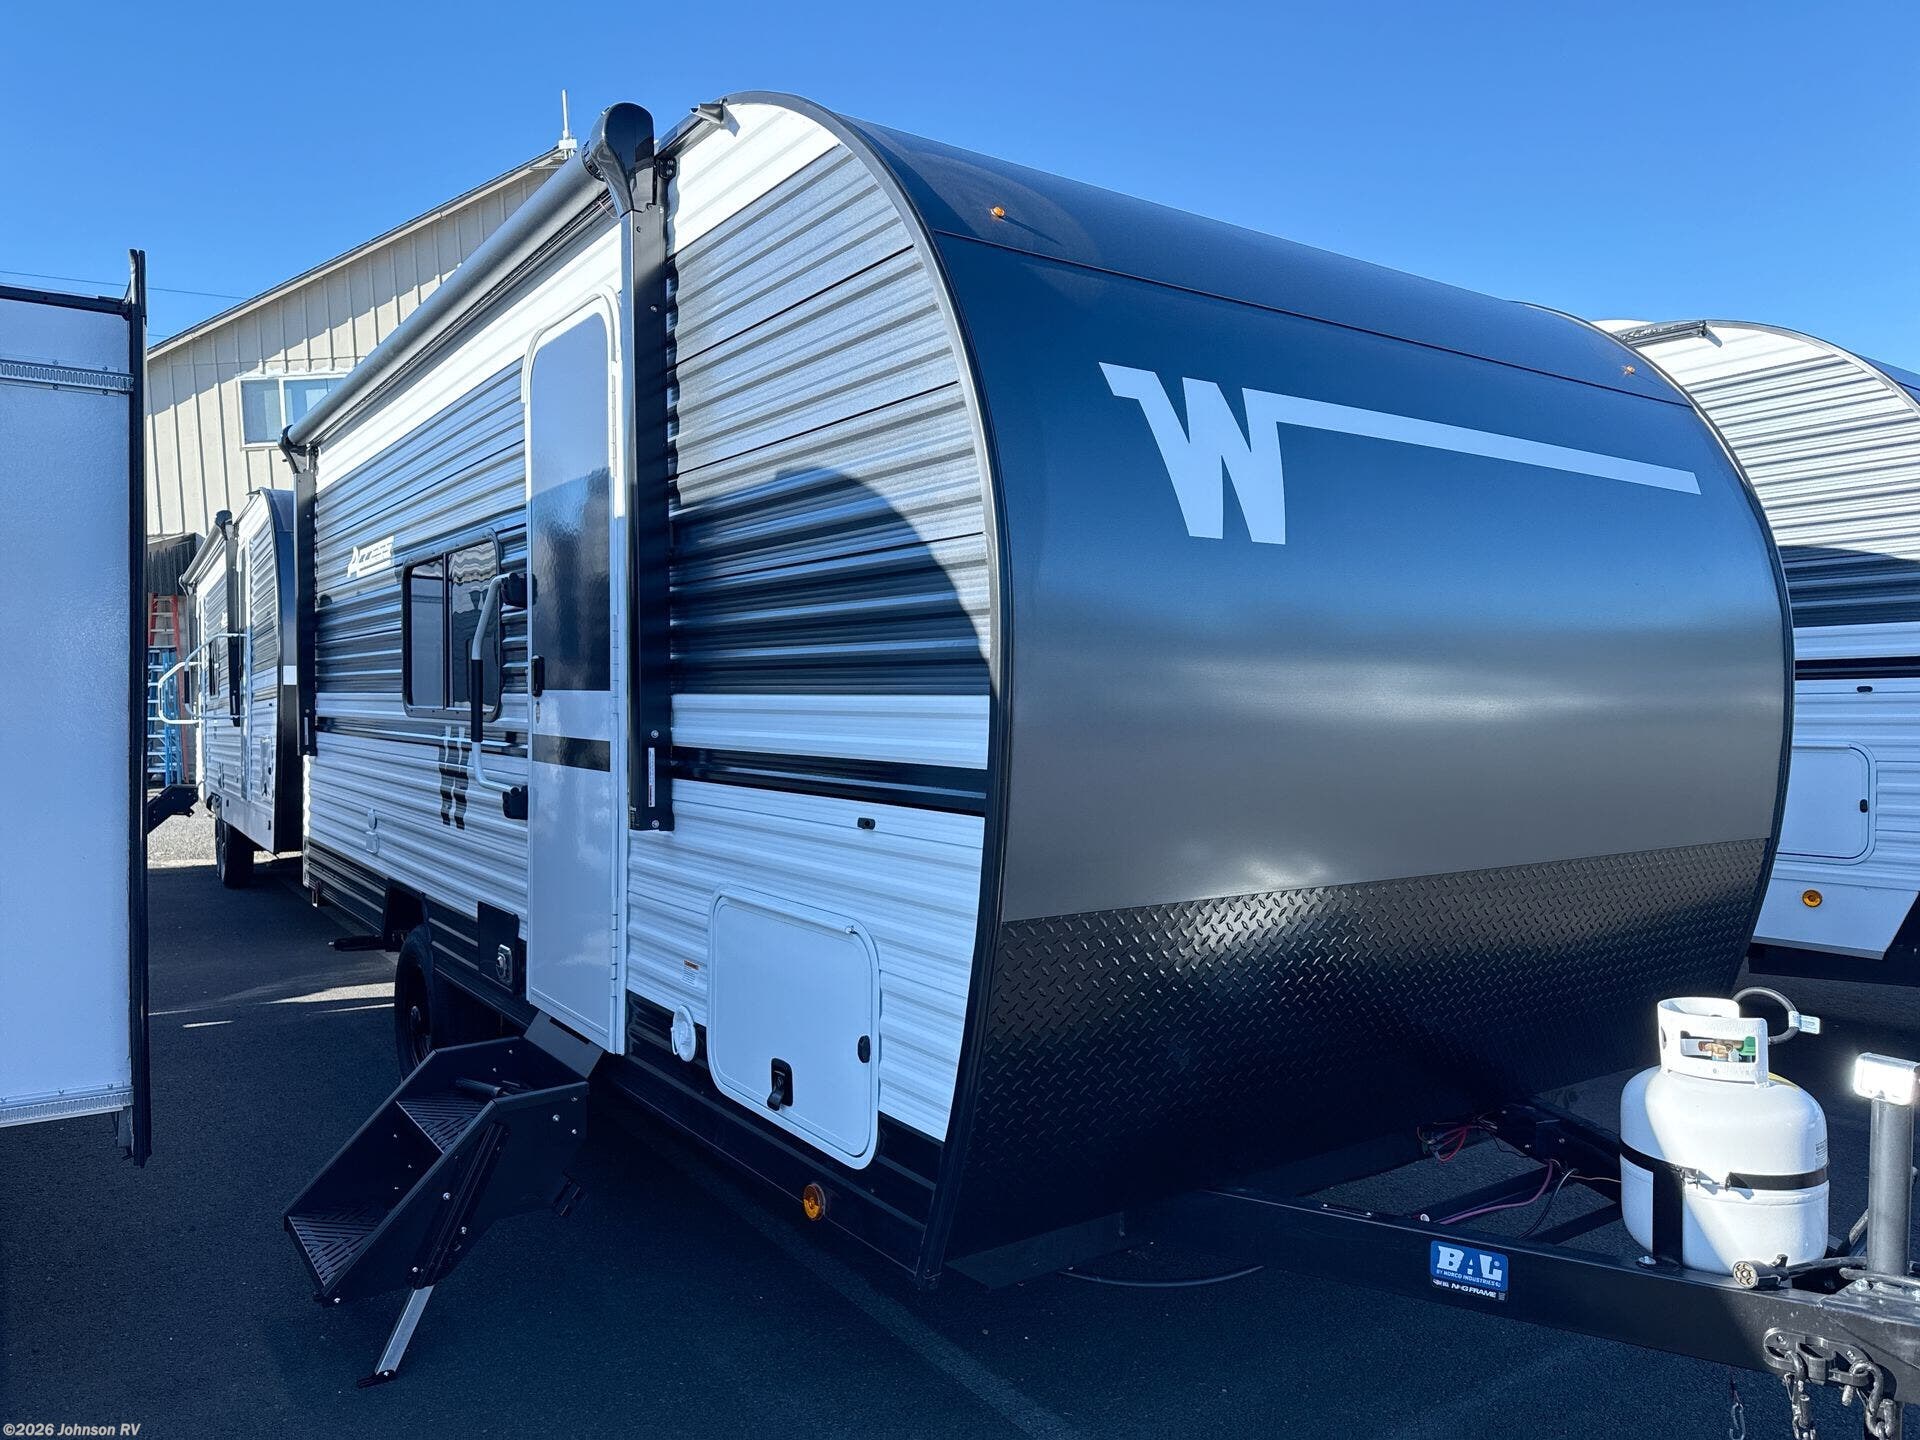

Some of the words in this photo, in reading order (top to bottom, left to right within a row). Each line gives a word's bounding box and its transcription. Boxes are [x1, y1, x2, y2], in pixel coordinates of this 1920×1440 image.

[1444, 1270, 1462, 1279] NORCO
[1463, 1275, 1495, 1287] INDUSTRIES
[1469, 1287, 1497, 1298] FRAME
